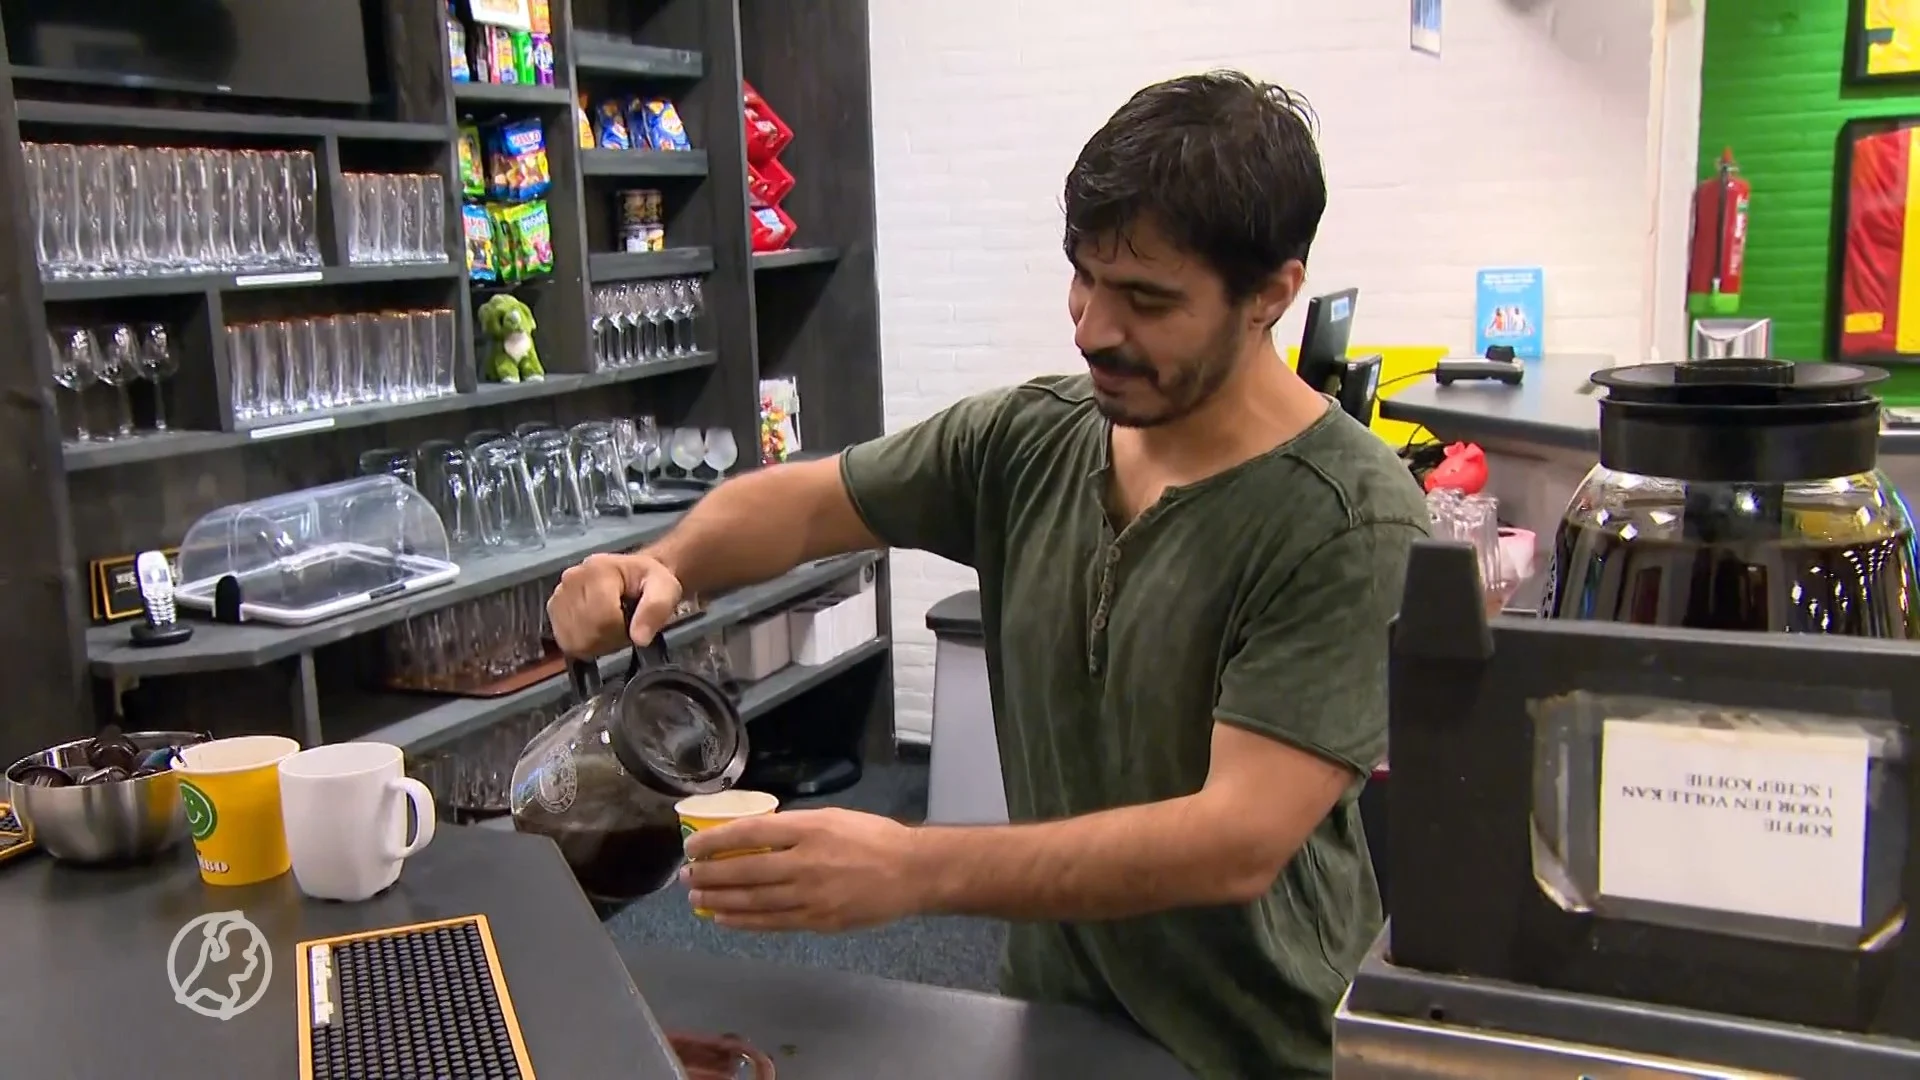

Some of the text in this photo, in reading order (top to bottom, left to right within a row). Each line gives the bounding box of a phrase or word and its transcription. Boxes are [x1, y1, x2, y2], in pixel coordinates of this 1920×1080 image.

[1687, 773, 1752, 792] KOFFIE
[1757, 780, 1820, 797] SCHEP
[1621, 785, 1833, 818] VOOR EEN VOLLE KAN
[1766, 818, 1833, 838] KOFFIE
